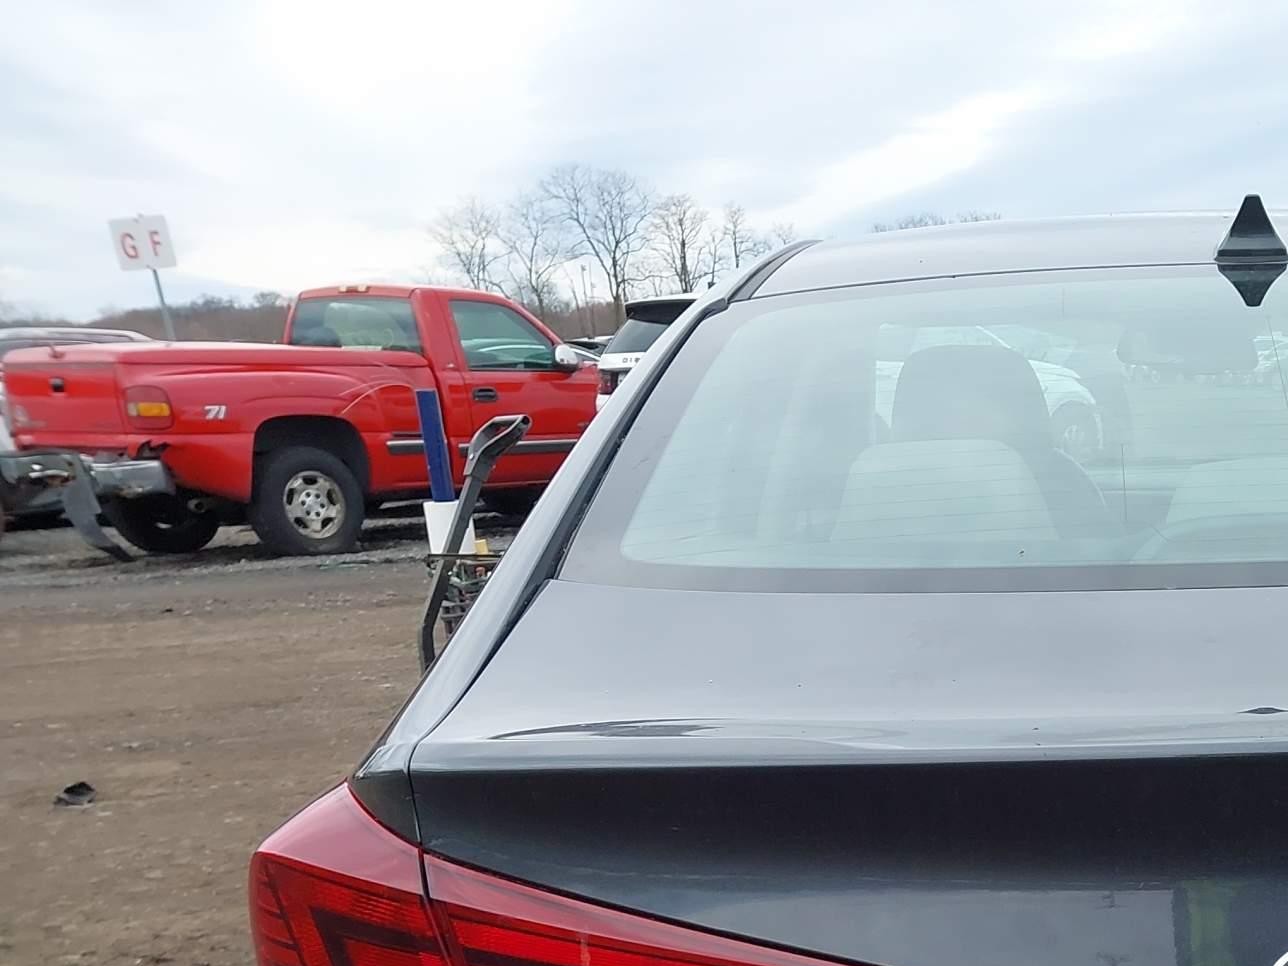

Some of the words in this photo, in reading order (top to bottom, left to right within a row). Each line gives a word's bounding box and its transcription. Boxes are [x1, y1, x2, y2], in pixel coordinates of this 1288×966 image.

[121, 232, 139, 259] G
[148, 230, 162, 256] F
[203, 404, 227, 420] 71
